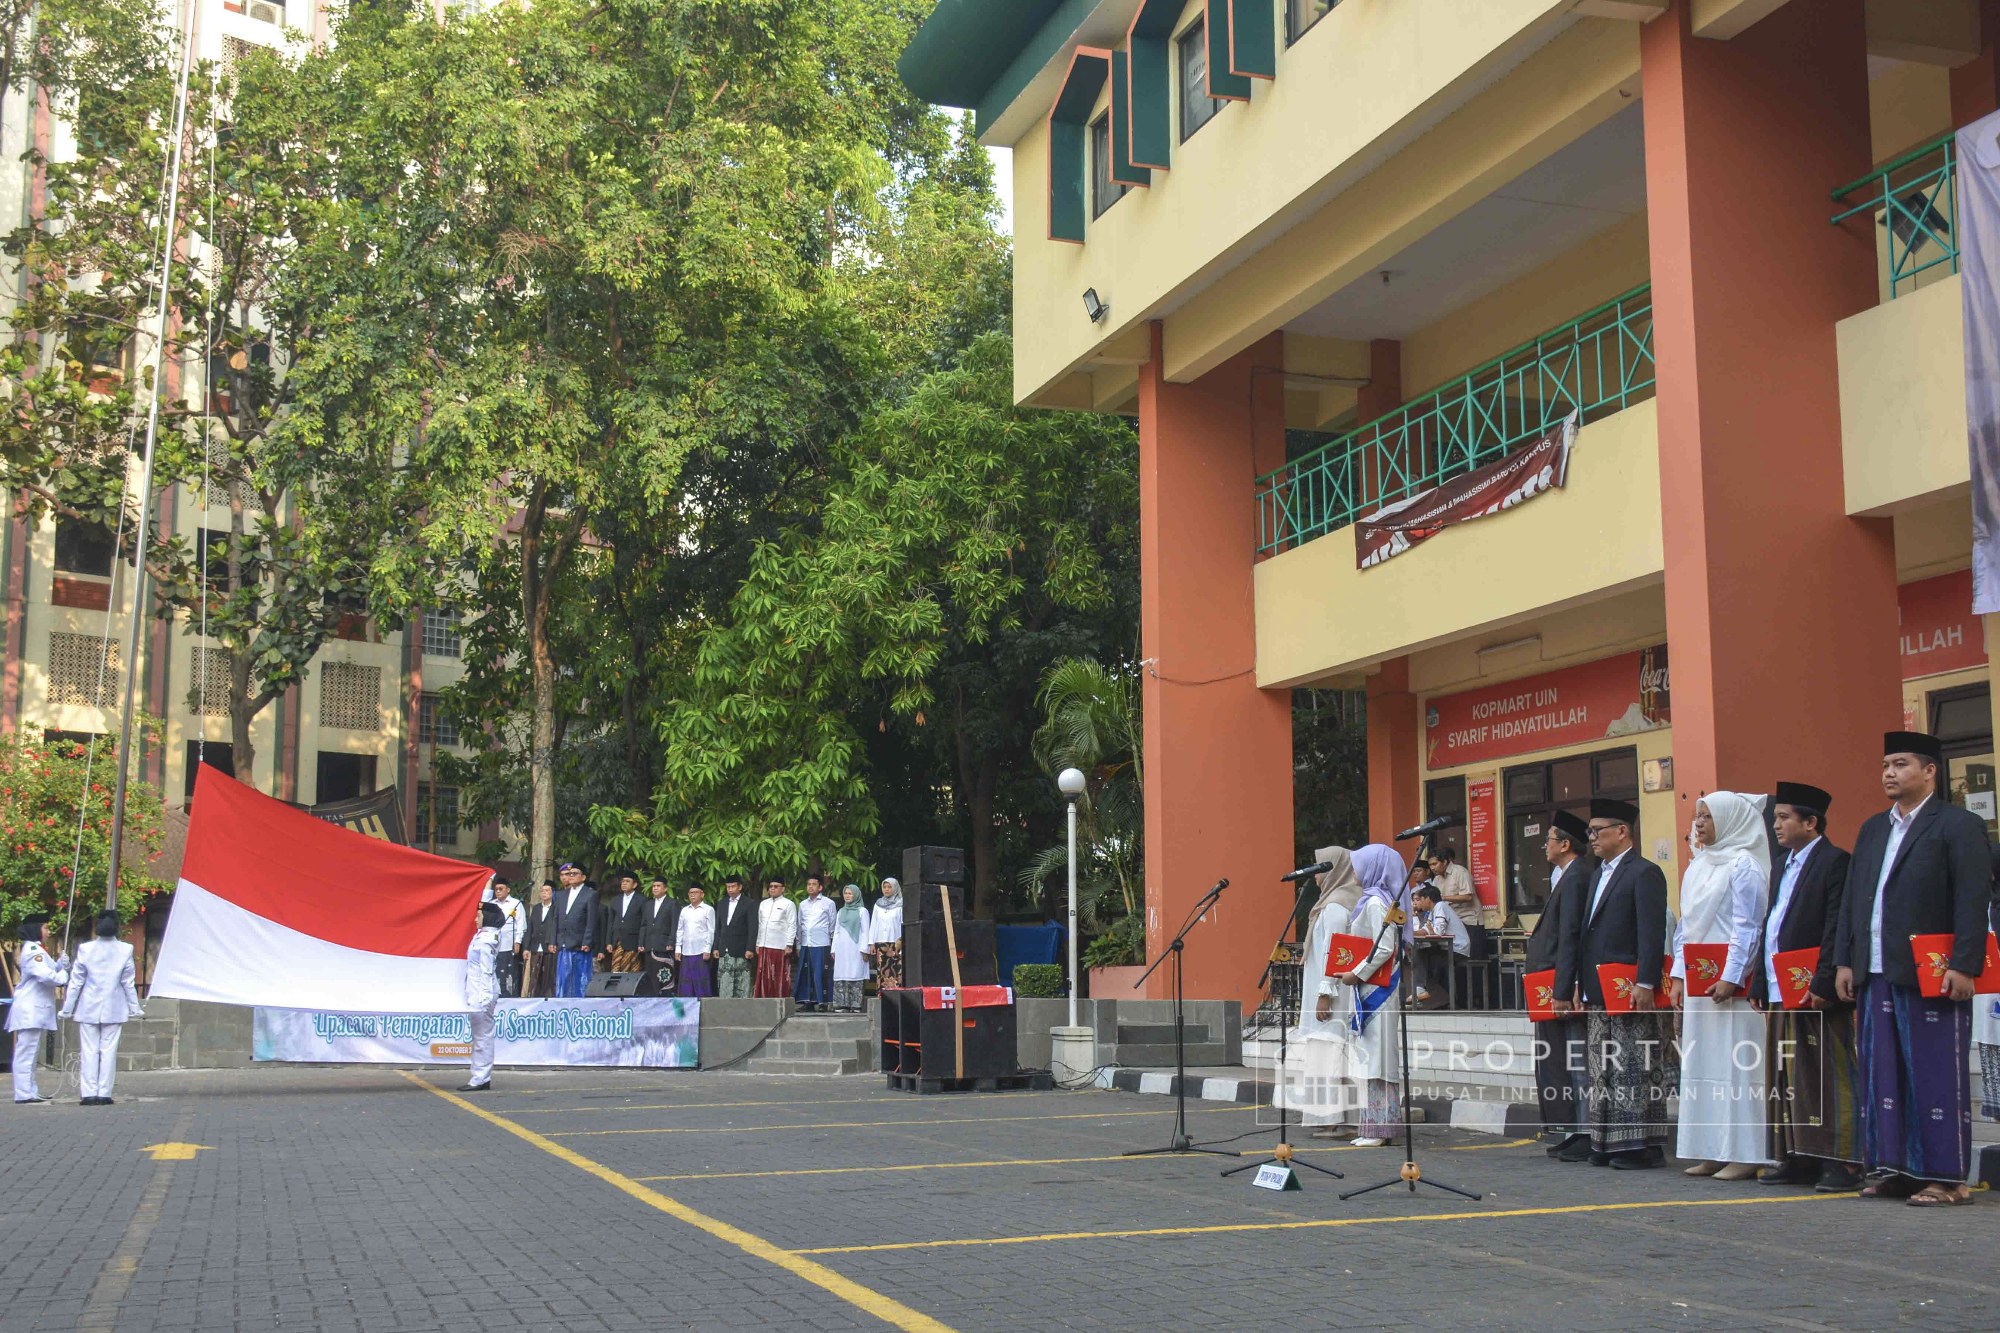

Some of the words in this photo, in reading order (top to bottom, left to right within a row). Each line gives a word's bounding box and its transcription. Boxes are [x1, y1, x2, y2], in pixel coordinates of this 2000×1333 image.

[1472, 693, 1532, 720] KOPMART
[1535, 688, 1557, 707] UIN
[1448, 726, 1488, 748] SYARIF
[1492, 706, 1588, 740] HIDAYATULLAH
[313, 1013, 378, 1044] Upacara
[378, 1014, 465, 1045] Peringatan
[505, 1008, 557, 1041] Santri
[557, 1007, 633, 1041] Nasional
